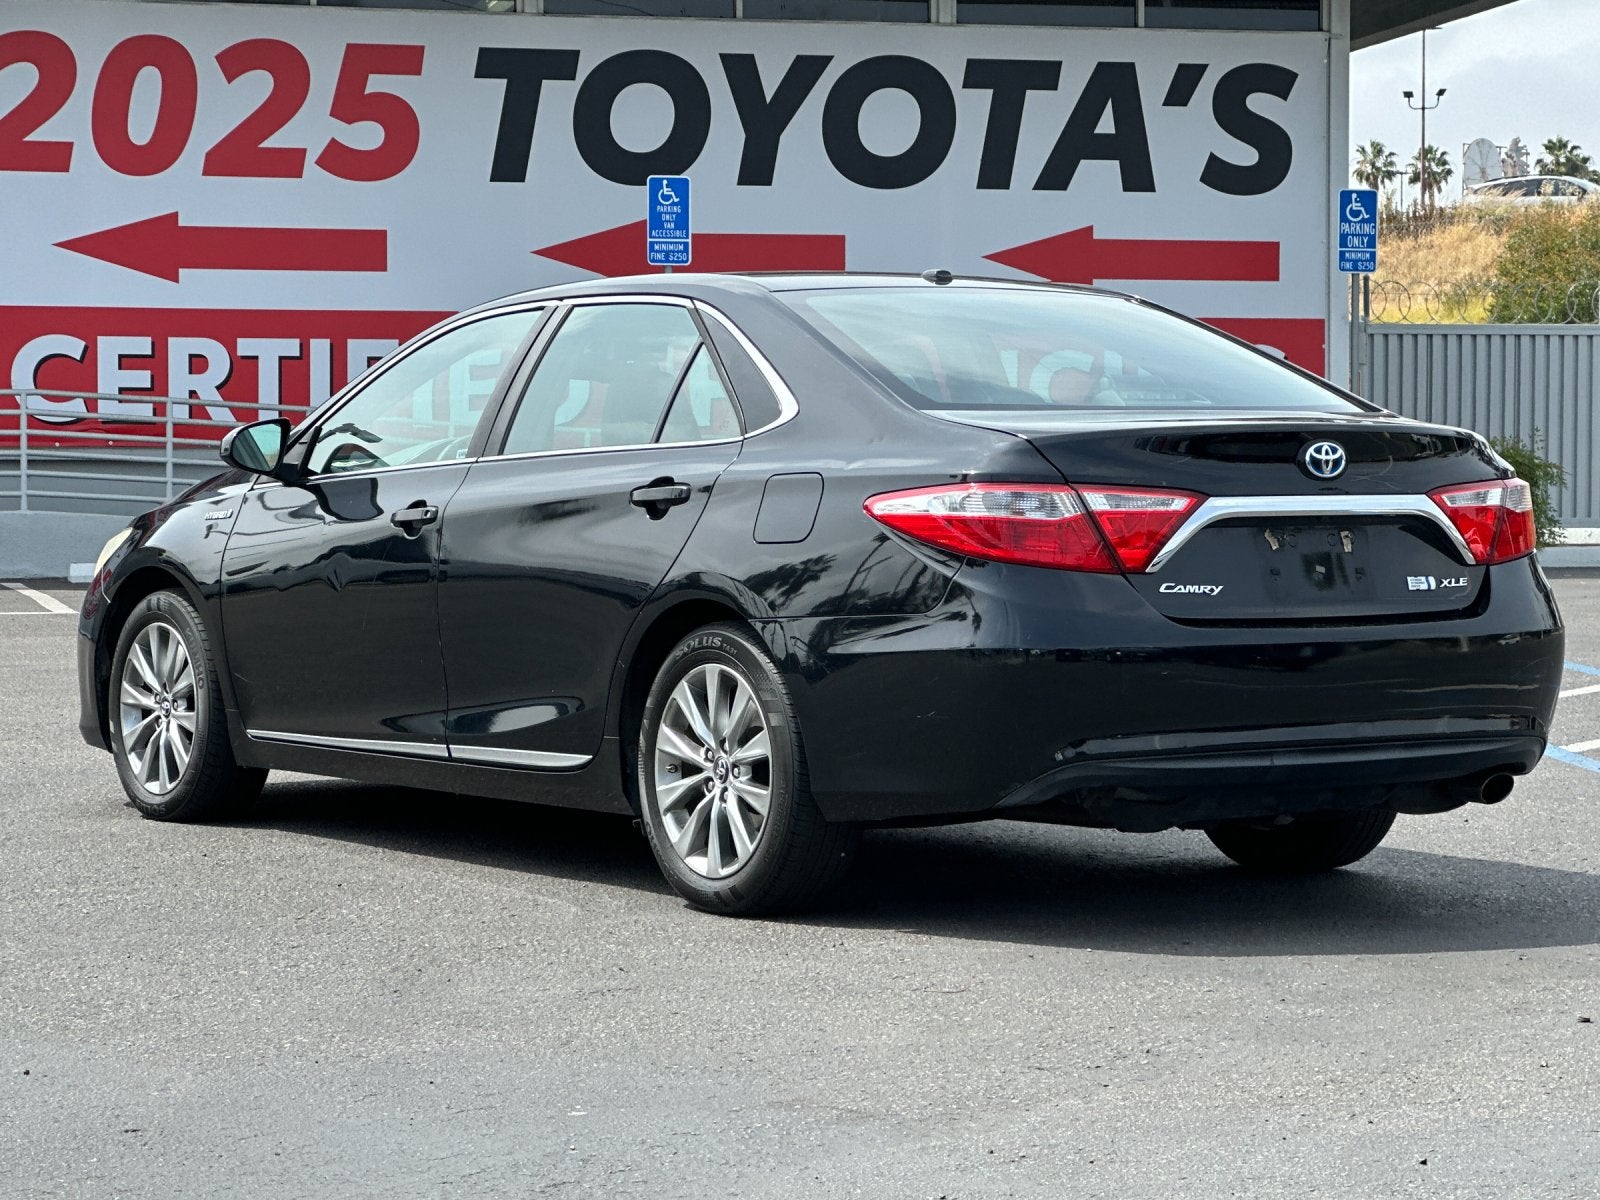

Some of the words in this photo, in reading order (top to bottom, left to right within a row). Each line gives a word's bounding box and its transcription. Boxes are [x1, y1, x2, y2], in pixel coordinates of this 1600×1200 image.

[0, 30, 422, 183] 2025
[474, 46, 1299, 197] TOYOTA'S
[656, 205, 681, 213] PARKING
[1340, 222, 1375, 235] PARKING
[651, 230, 687, 238] ACCESSIBLE
[1347, 236, 1368, 248] ONLY
[654, 243, 684, 251] MINIMUM
[650, 252, 666, 261] FINE
[668, 252, 687, 261] $250
[1344, 251, 1370, 260] MINIMUM
[1340, 261, 1353, 270] FINE
[1357, 261, 1374, 270] $250
[1439, 577, 1468, 588] XLE
[1159, 582, 1224, 596] CAMRY
